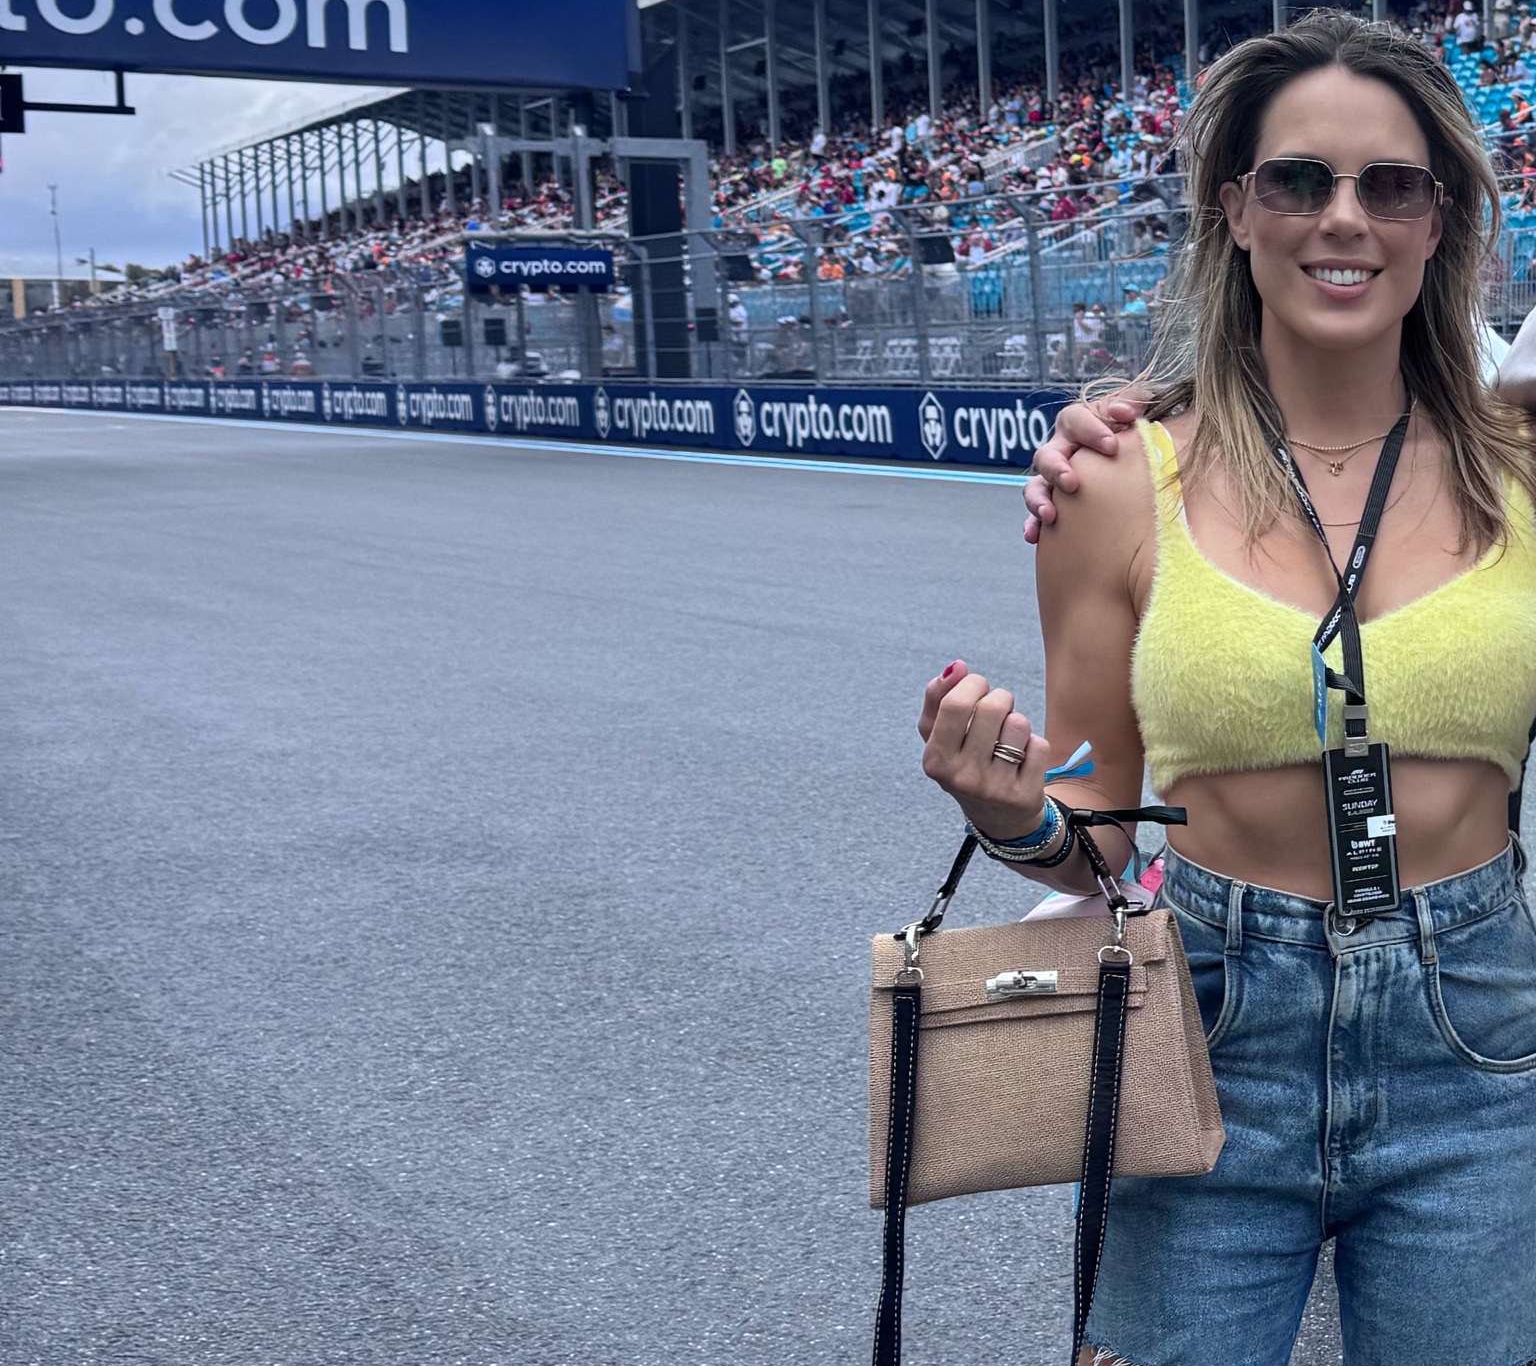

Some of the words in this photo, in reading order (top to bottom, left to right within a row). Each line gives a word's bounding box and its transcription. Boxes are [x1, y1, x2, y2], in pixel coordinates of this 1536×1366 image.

[500, 259, 606, 276] crypto.com
[409, 388, 474, 424] crypto.com
[501, 390, 580, 431] crypto.com
[613, 392, 715, 438] crypto.com
[760, 395, 893, 447] crypto.com
[1342, 799, 1378, 811] SUNDAY
